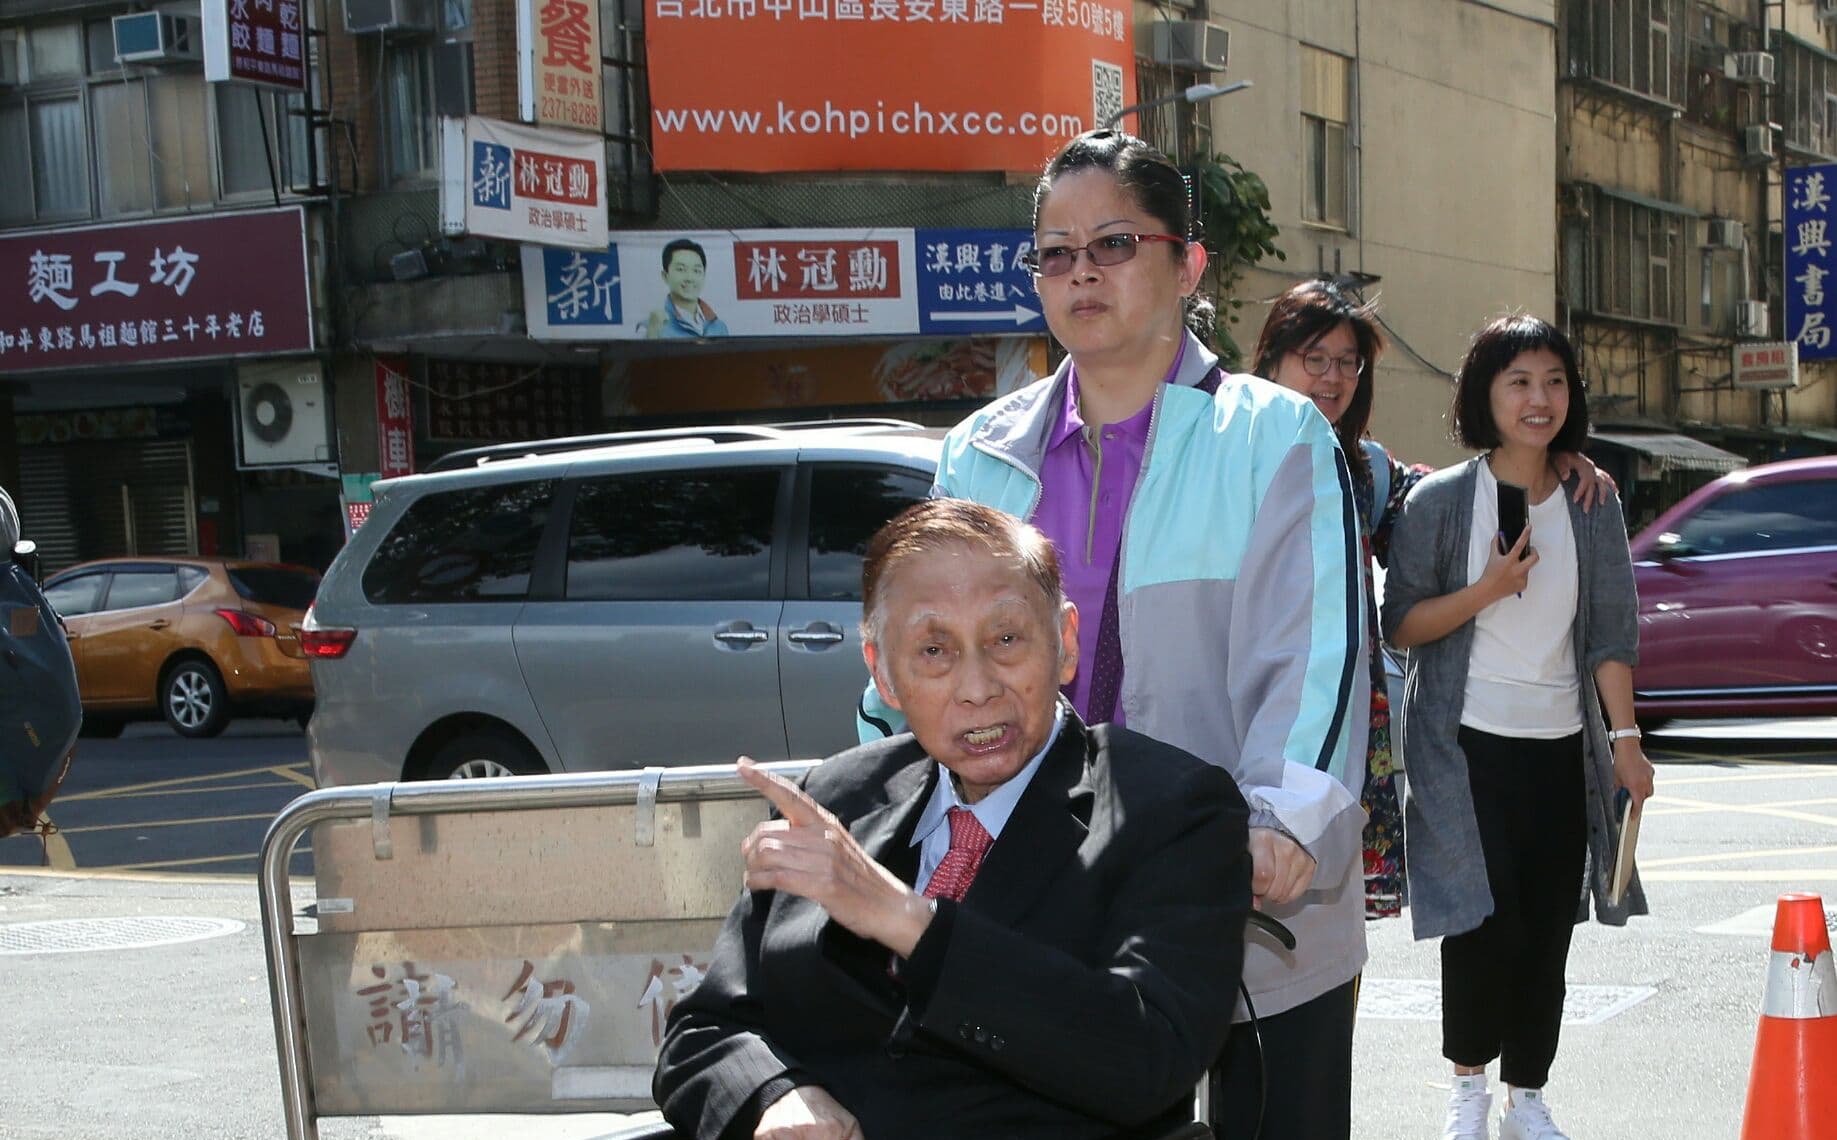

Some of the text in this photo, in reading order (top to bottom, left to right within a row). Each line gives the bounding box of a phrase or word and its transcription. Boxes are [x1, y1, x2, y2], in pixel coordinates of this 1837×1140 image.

[541, 0, 593, 74] 餐
[542, 96, 599, 126] 2371-8288
[655, 101, 1082, 138] www.kohpichxcc.com
[474, 146, 510, 206] 新
[528, 206, 588, 233] 政治學碩士
[27, 245, 200, 311] 麵工坊
[1791, 171, 1831, 349] 漢興書局
[547, 248, 620, 321] 新
[938, 281, 1025, 302] 由此巷進入
[773, 303, 869, 325] 政治學碩士
